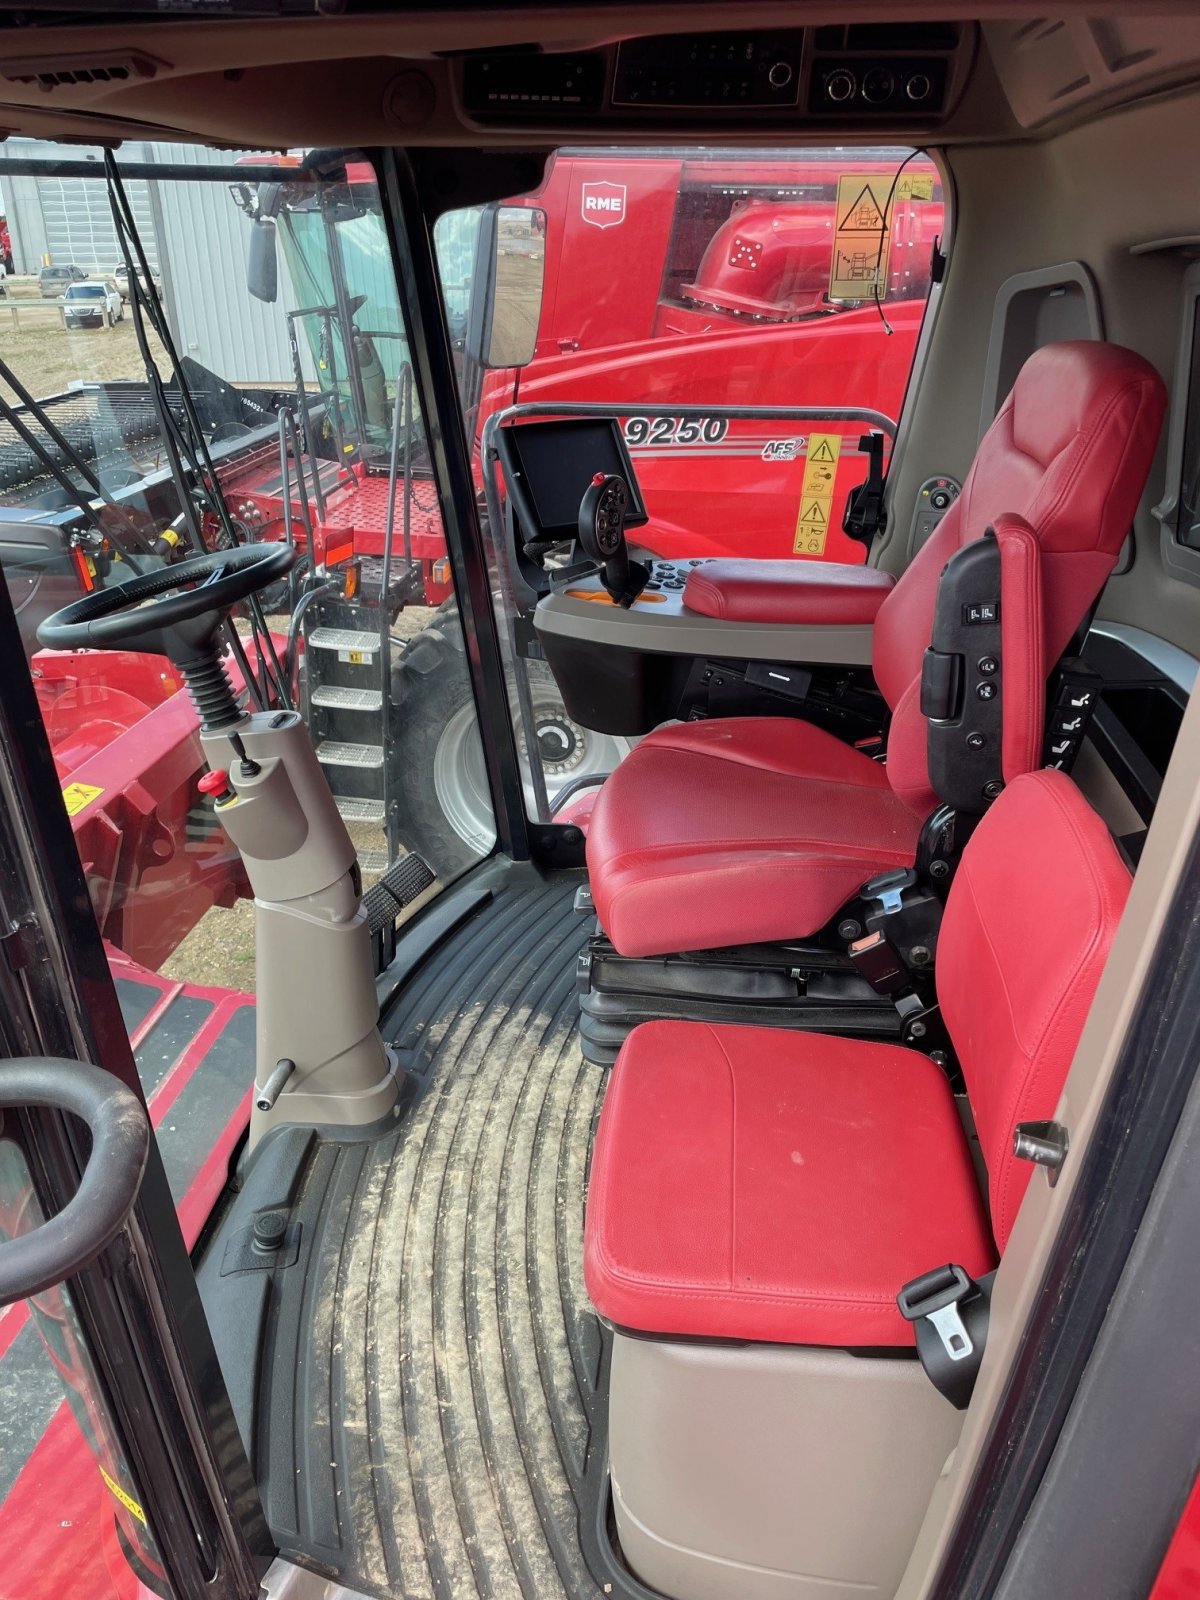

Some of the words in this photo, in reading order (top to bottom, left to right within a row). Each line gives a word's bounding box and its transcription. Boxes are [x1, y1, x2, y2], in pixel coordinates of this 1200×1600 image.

[586, 197, 621, 211] RME
[624, 417, 729, 445] 9250
[763, 442, 794, 454] AFS
[797, 541, 803, 549] 2
